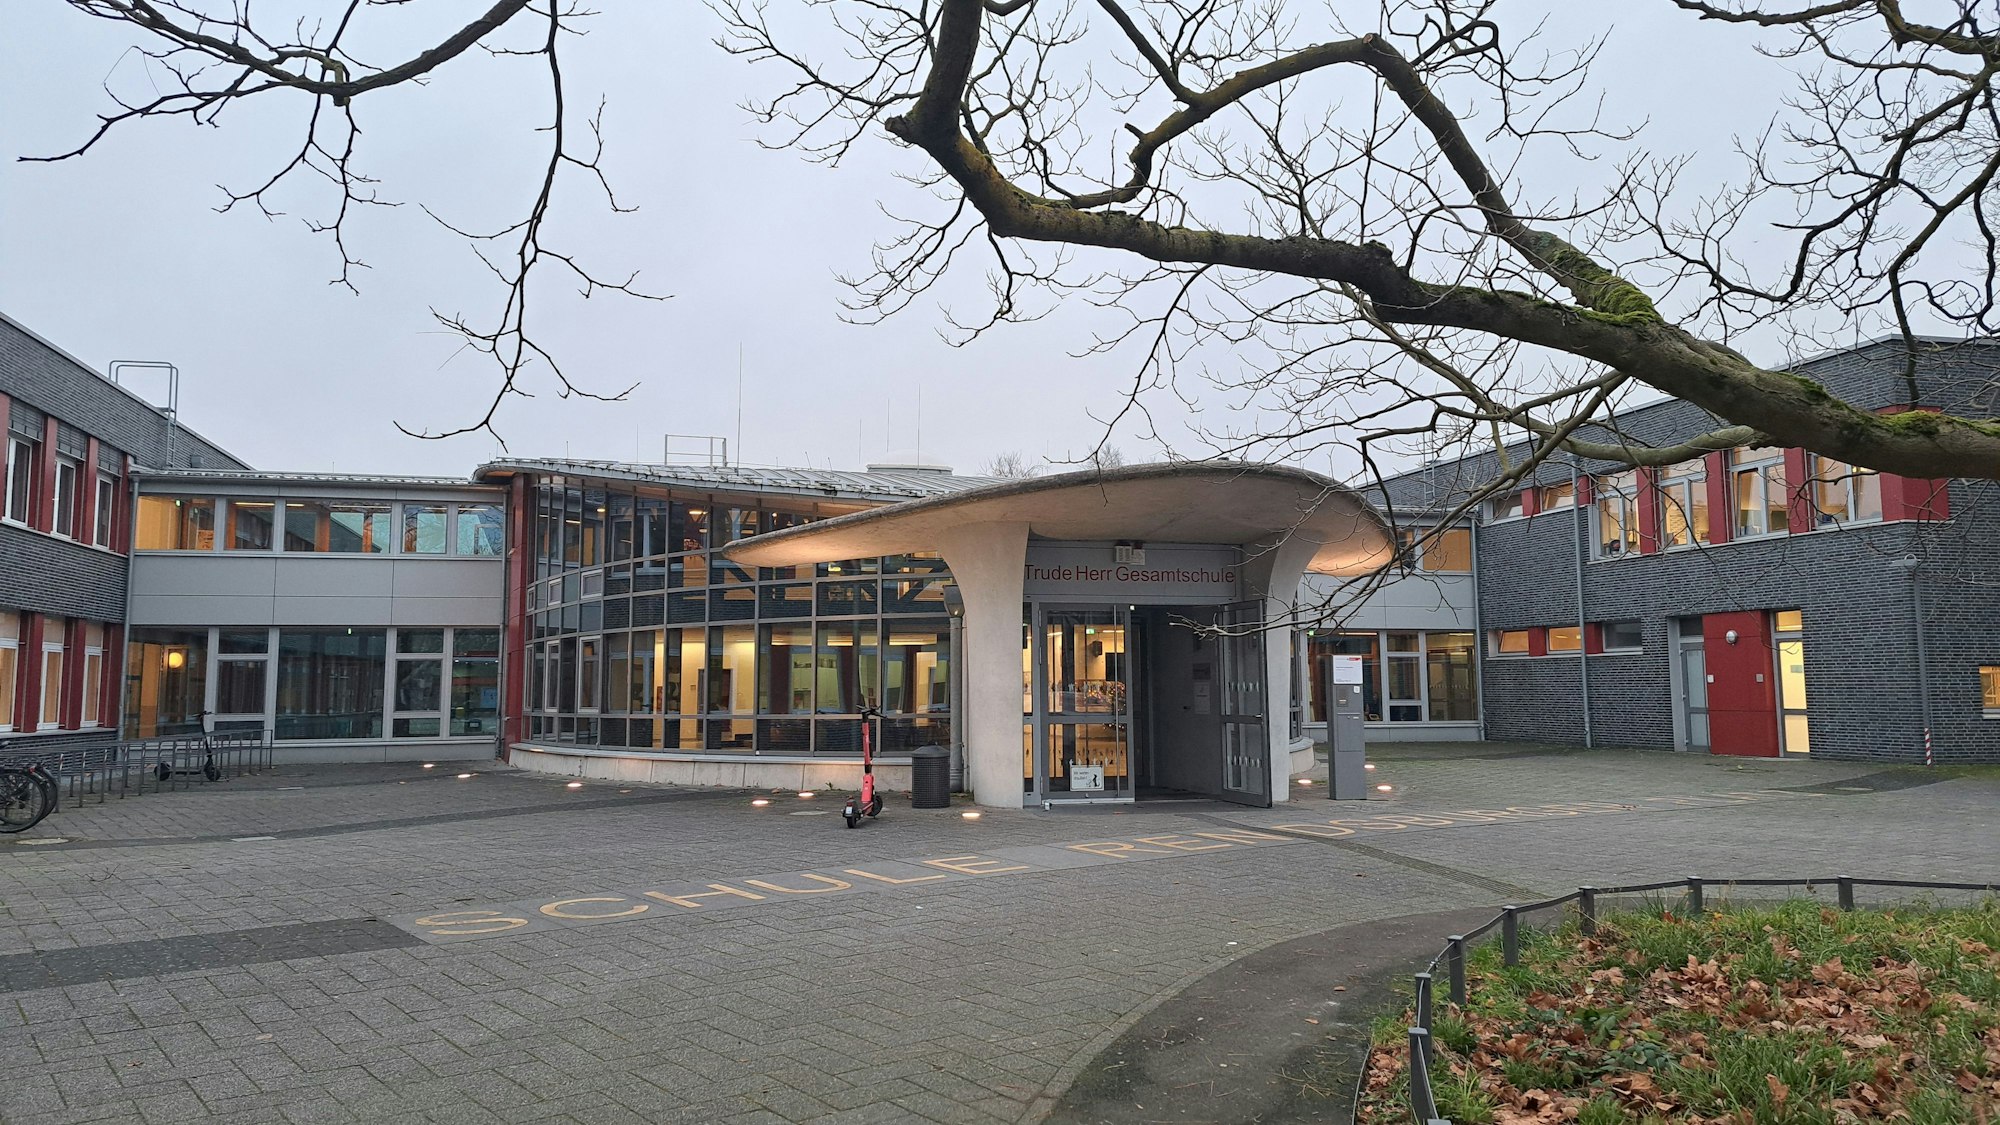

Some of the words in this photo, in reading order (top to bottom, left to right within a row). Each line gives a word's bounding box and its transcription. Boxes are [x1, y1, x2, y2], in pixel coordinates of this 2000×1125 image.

[1025, 564, 1072, 581] Trude
[1077, 565, 1113, 581] Herr
[1115, 566, 1235, 583] Gesamtschule
[414, 854, 1030, 936] SCHULE
